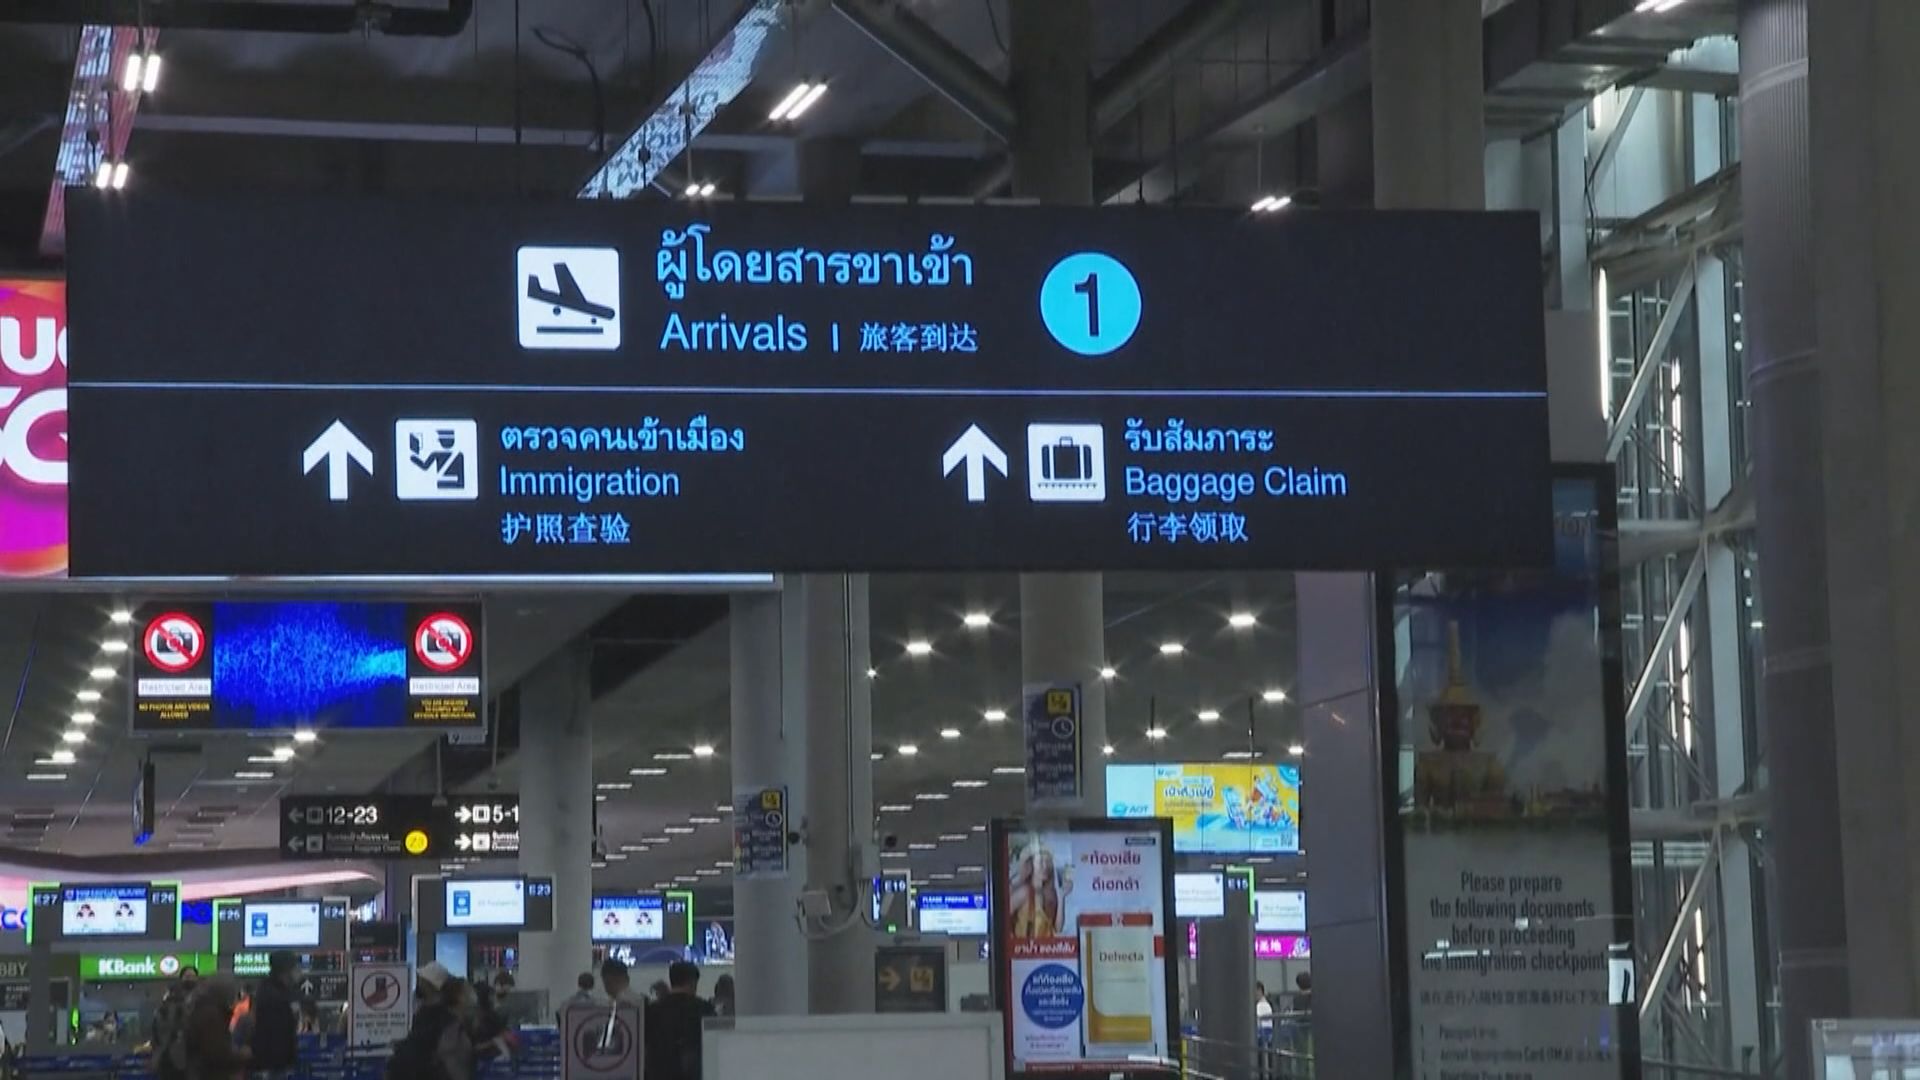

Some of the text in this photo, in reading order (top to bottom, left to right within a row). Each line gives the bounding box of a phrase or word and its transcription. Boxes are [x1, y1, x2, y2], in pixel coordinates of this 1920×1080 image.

[655, 224, 974, 299] ผู้โดยสารขาเข้า
[1074, 272, 1100, 338] 1
[659, 313, 808, 352] Arrivals
[858, 321, 979, 354] 旅客到达
[501, 415, 745, 452] ตรวจคนเข้าเมือง
[1125, 418, 1274, 452] รับสัมภาระ
[500, 466, 680, 500] Immigration
[1125, 467, 1347, 501] Baggage Claim
[501, 513, 631, 545] 护照查验
[1127, 512, 1248, 543] 行李领取
[326, 805, 378, 825] 12-23
[1461, 871, 1562, 896] Please prepare
[1430, 897, 1596, 923] the following documents
[1452, 923, 1576, 948] before proceeding
[98, 957, 156, 976] KBank
[1446, 952, 1527, 976] immigration
